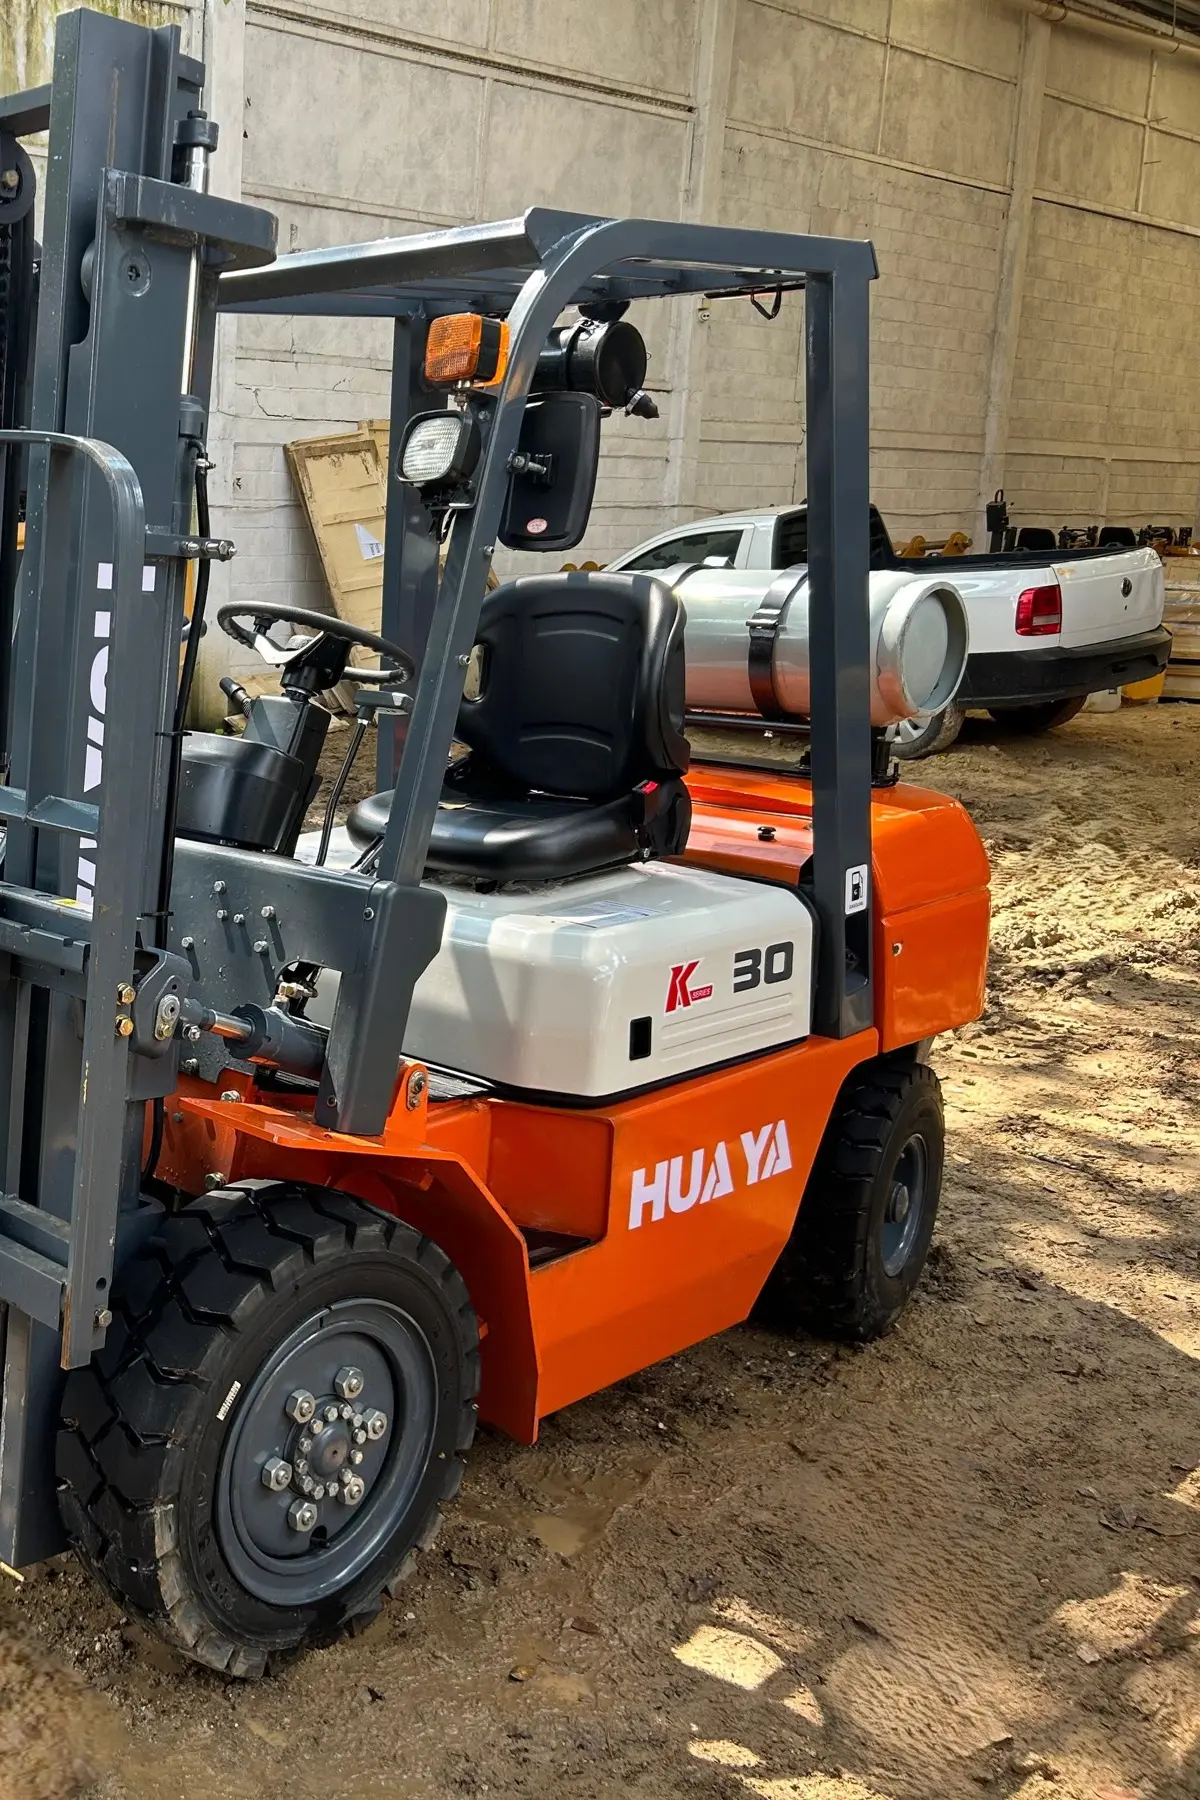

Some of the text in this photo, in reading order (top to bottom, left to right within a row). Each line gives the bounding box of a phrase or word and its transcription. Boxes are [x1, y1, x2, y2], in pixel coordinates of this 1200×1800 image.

[665, 960, 711, 1013] K SERIES
[733, 941, 794, 993] 30
